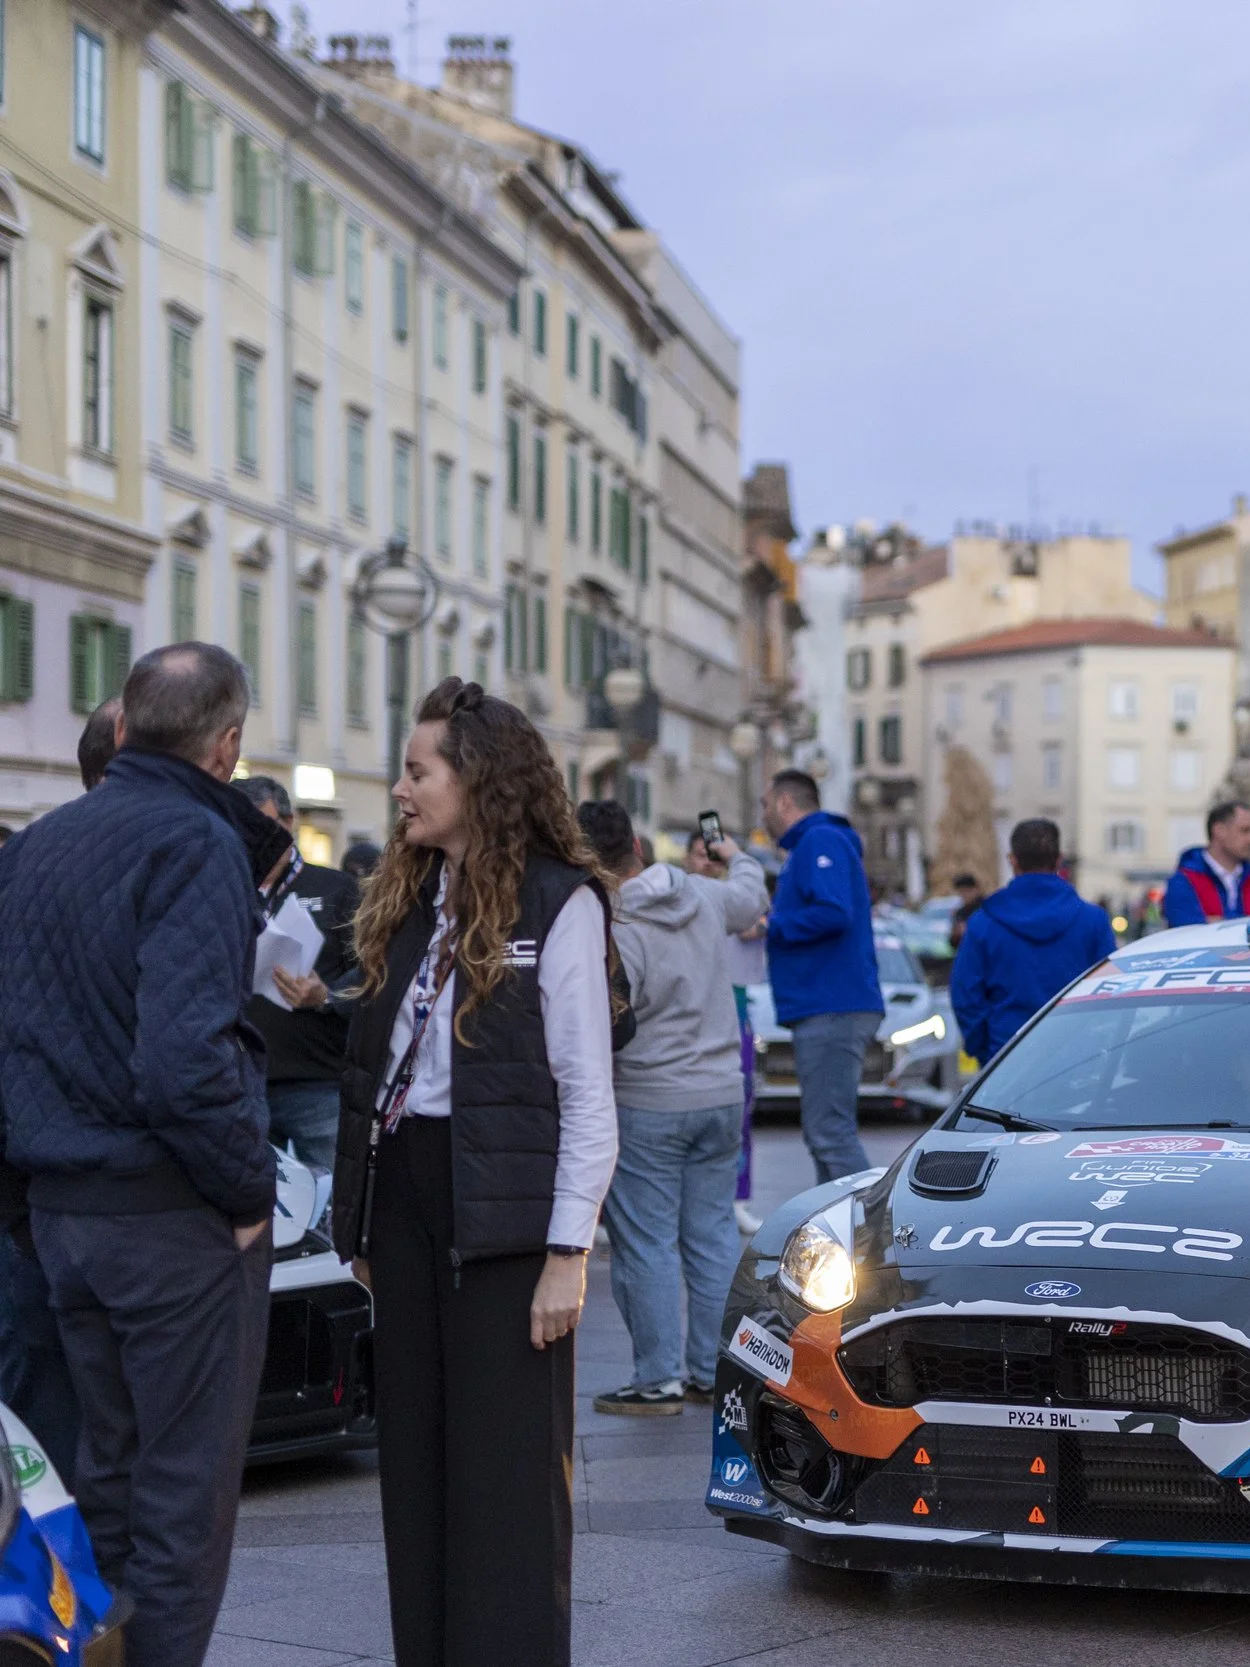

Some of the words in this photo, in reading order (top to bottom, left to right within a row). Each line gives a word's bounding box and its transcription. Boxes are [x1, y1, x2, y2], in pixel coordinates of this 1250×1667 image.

[1086, 1165, 1200, 1173] JUNIOR
[1067, 1171, 1201, 1184] WRC
[929, 1221, 1244, 1262] WRC2
[1032, 1282, 1072, 1297] Ford
[1068, 1321, 1127, 1337] Rally2
[1008, 1411, 1045, 1427] PX24
[1050, 1413, 1078, 1428] BWL
[724, 1462, 748, 1482] W
